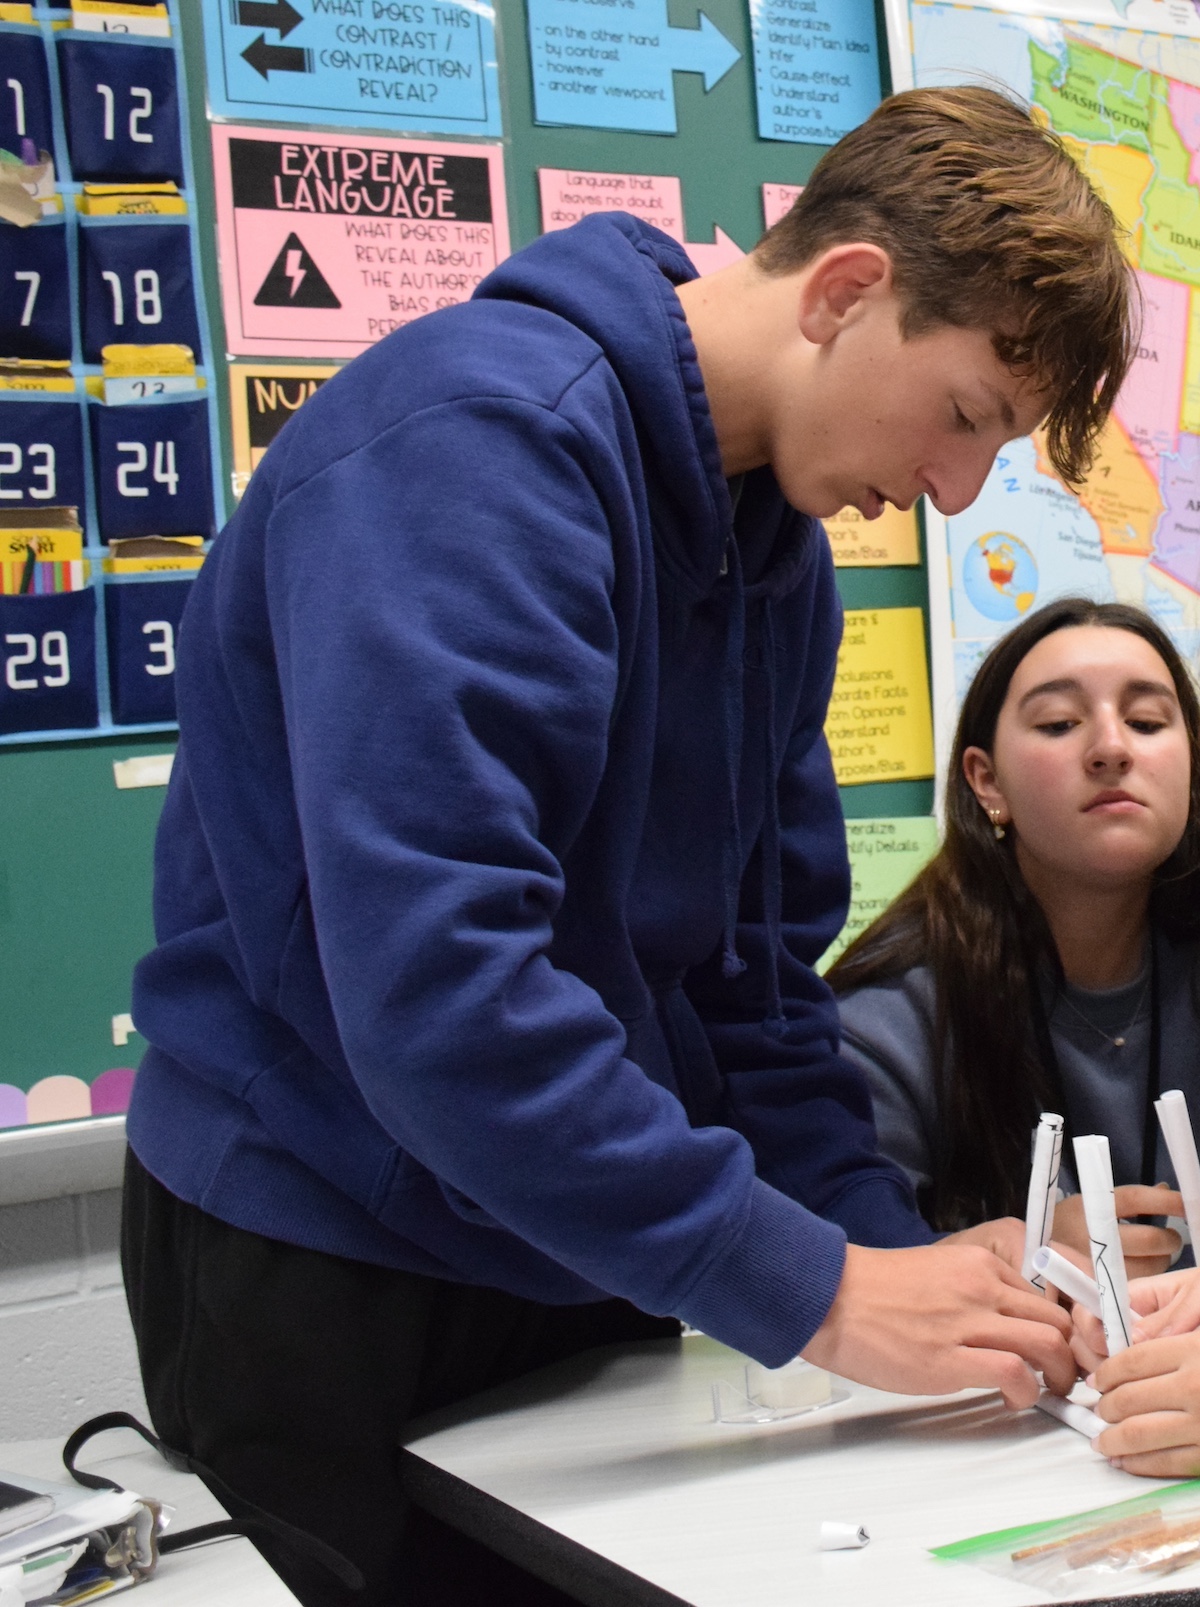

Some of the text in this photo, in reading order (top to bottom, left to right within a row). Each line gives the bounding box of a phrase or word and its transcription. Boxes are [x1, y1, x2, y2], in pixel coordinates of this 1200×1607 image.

[312, 0, 364, 18] WHAT
[373, 1, 424, 23] DOES
[336, 24, 437, 50] CONTRAST
[545, 26, 659, 47] on the other hand
[545, 42, 620, 61] by contrast
[547, 61, 603, 77] however
[357, 78, 438, 102] REVEAL?
[549, 80, 666, 101] another viewpoint
[772, 84, 839, 103] Understand
[96, 83, 153, 143] 12
[773, 105, 822, 119] author's
[1060, 87, 1150, 132] WASHINGTON
[281, 144, 447, 186] EXTREME
[566, 171, 653, 190] Language that
[275, 175, 456, 218] LANGUAGE
[560, 190, 663, 209] leaves no doubt
[345, 221, 393, 239] WHAT
[400, 223, 448, 242] DOES
[355, 245, 483, 268] REVEAL ABOUT
[360, 270, 392, 287] THE
[102, 269, 162, 326] 18
[0, 443, 56, 499] 23
[116, 441, 179, 497] 24
[5, 630, 70, 690] 29
[874, 686, 908, 699] Facts
[852, 705, 906, 721] Opinions
[876, 841, 919, 853] Details
